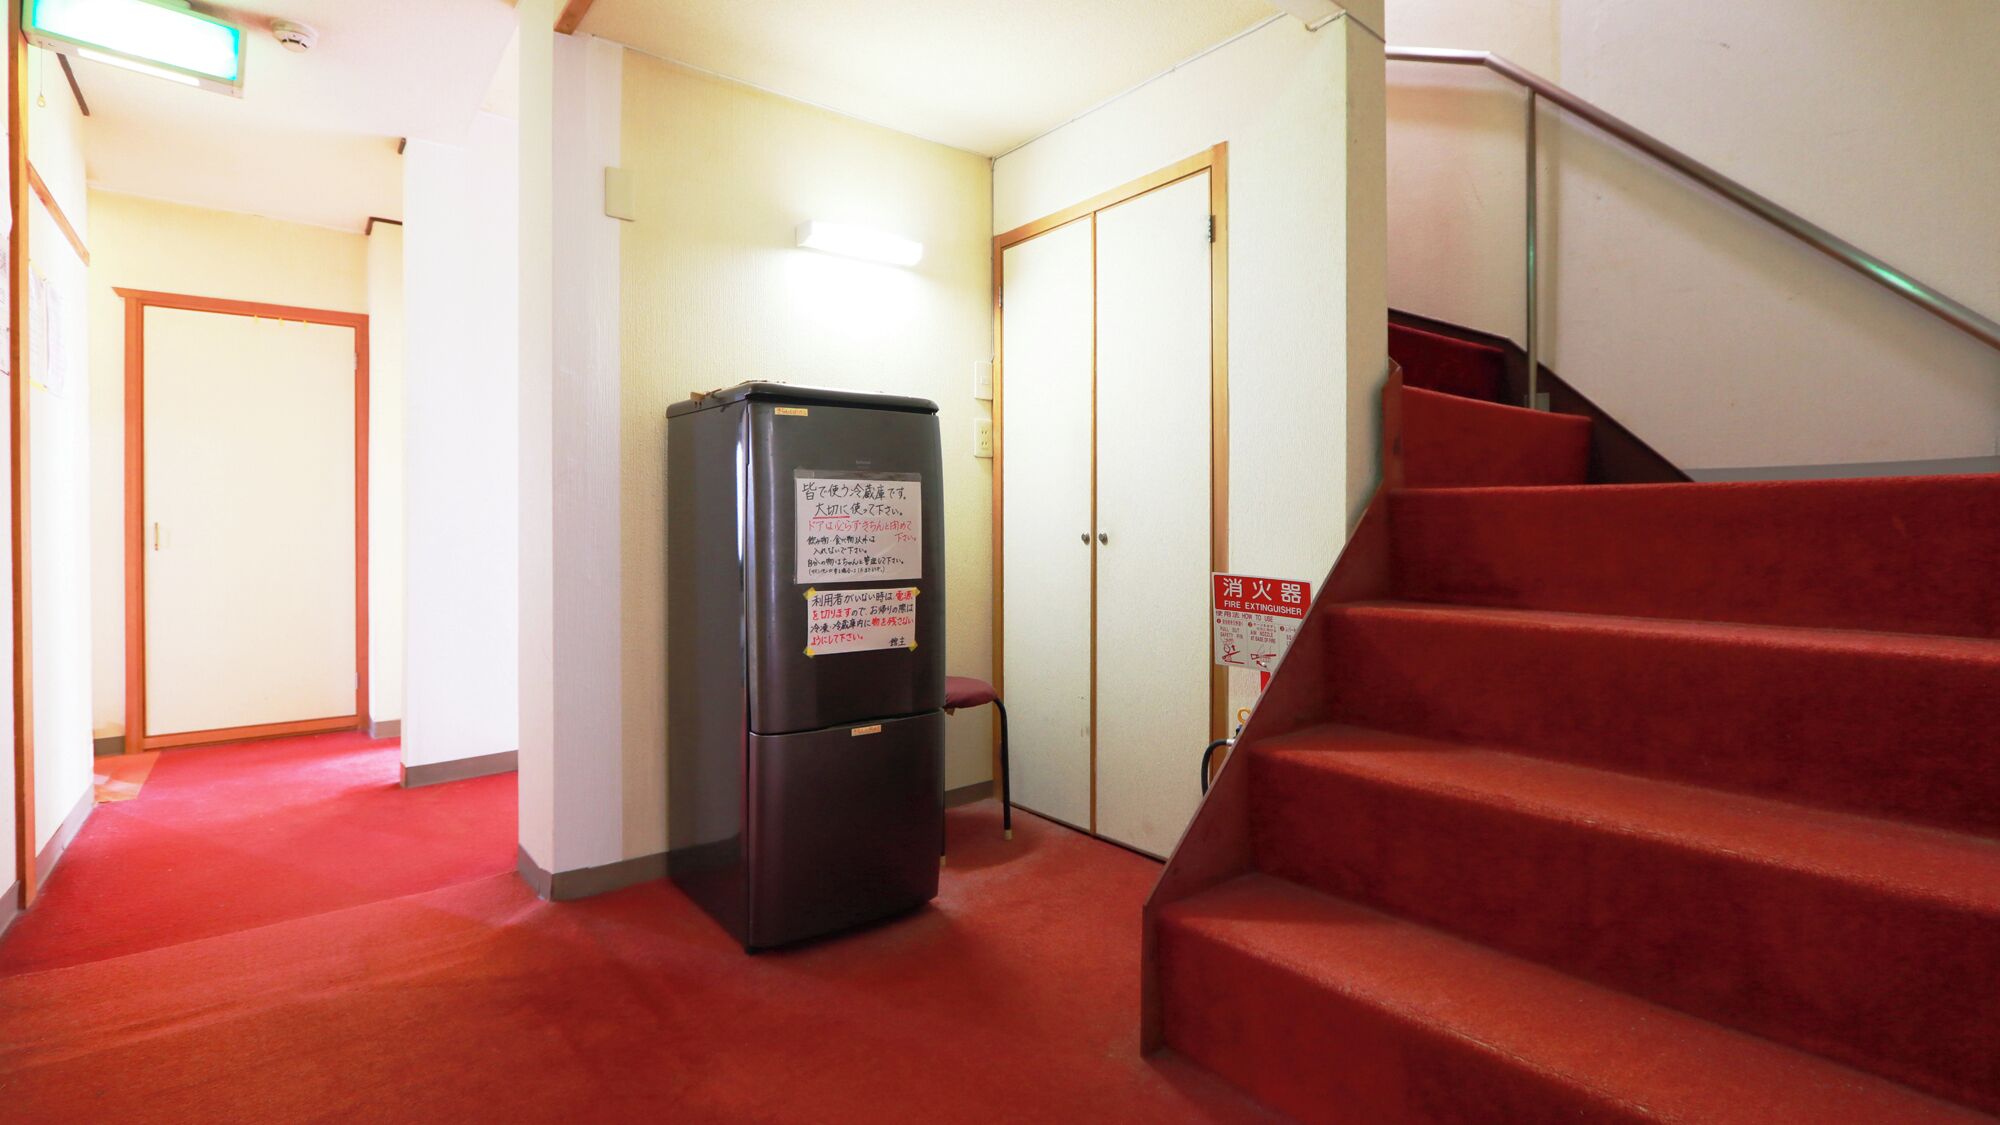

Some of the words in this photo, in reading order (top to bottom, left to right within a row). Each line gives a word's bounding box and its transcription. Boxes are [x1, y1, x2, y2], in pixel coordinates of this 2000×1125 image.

[802, 481, 907, 501] 皆で使う冷蔵庫です。
[815, 502, 903, 517] 大切に使って下さい。
[1223, 577, 1302, 604] 消火器
[1224, 600, 1241, 609] FIRE
[1245, 602, 1302, 616] EXTINGUISHER
[810, 633, 864, 647] ようにして下さい。
